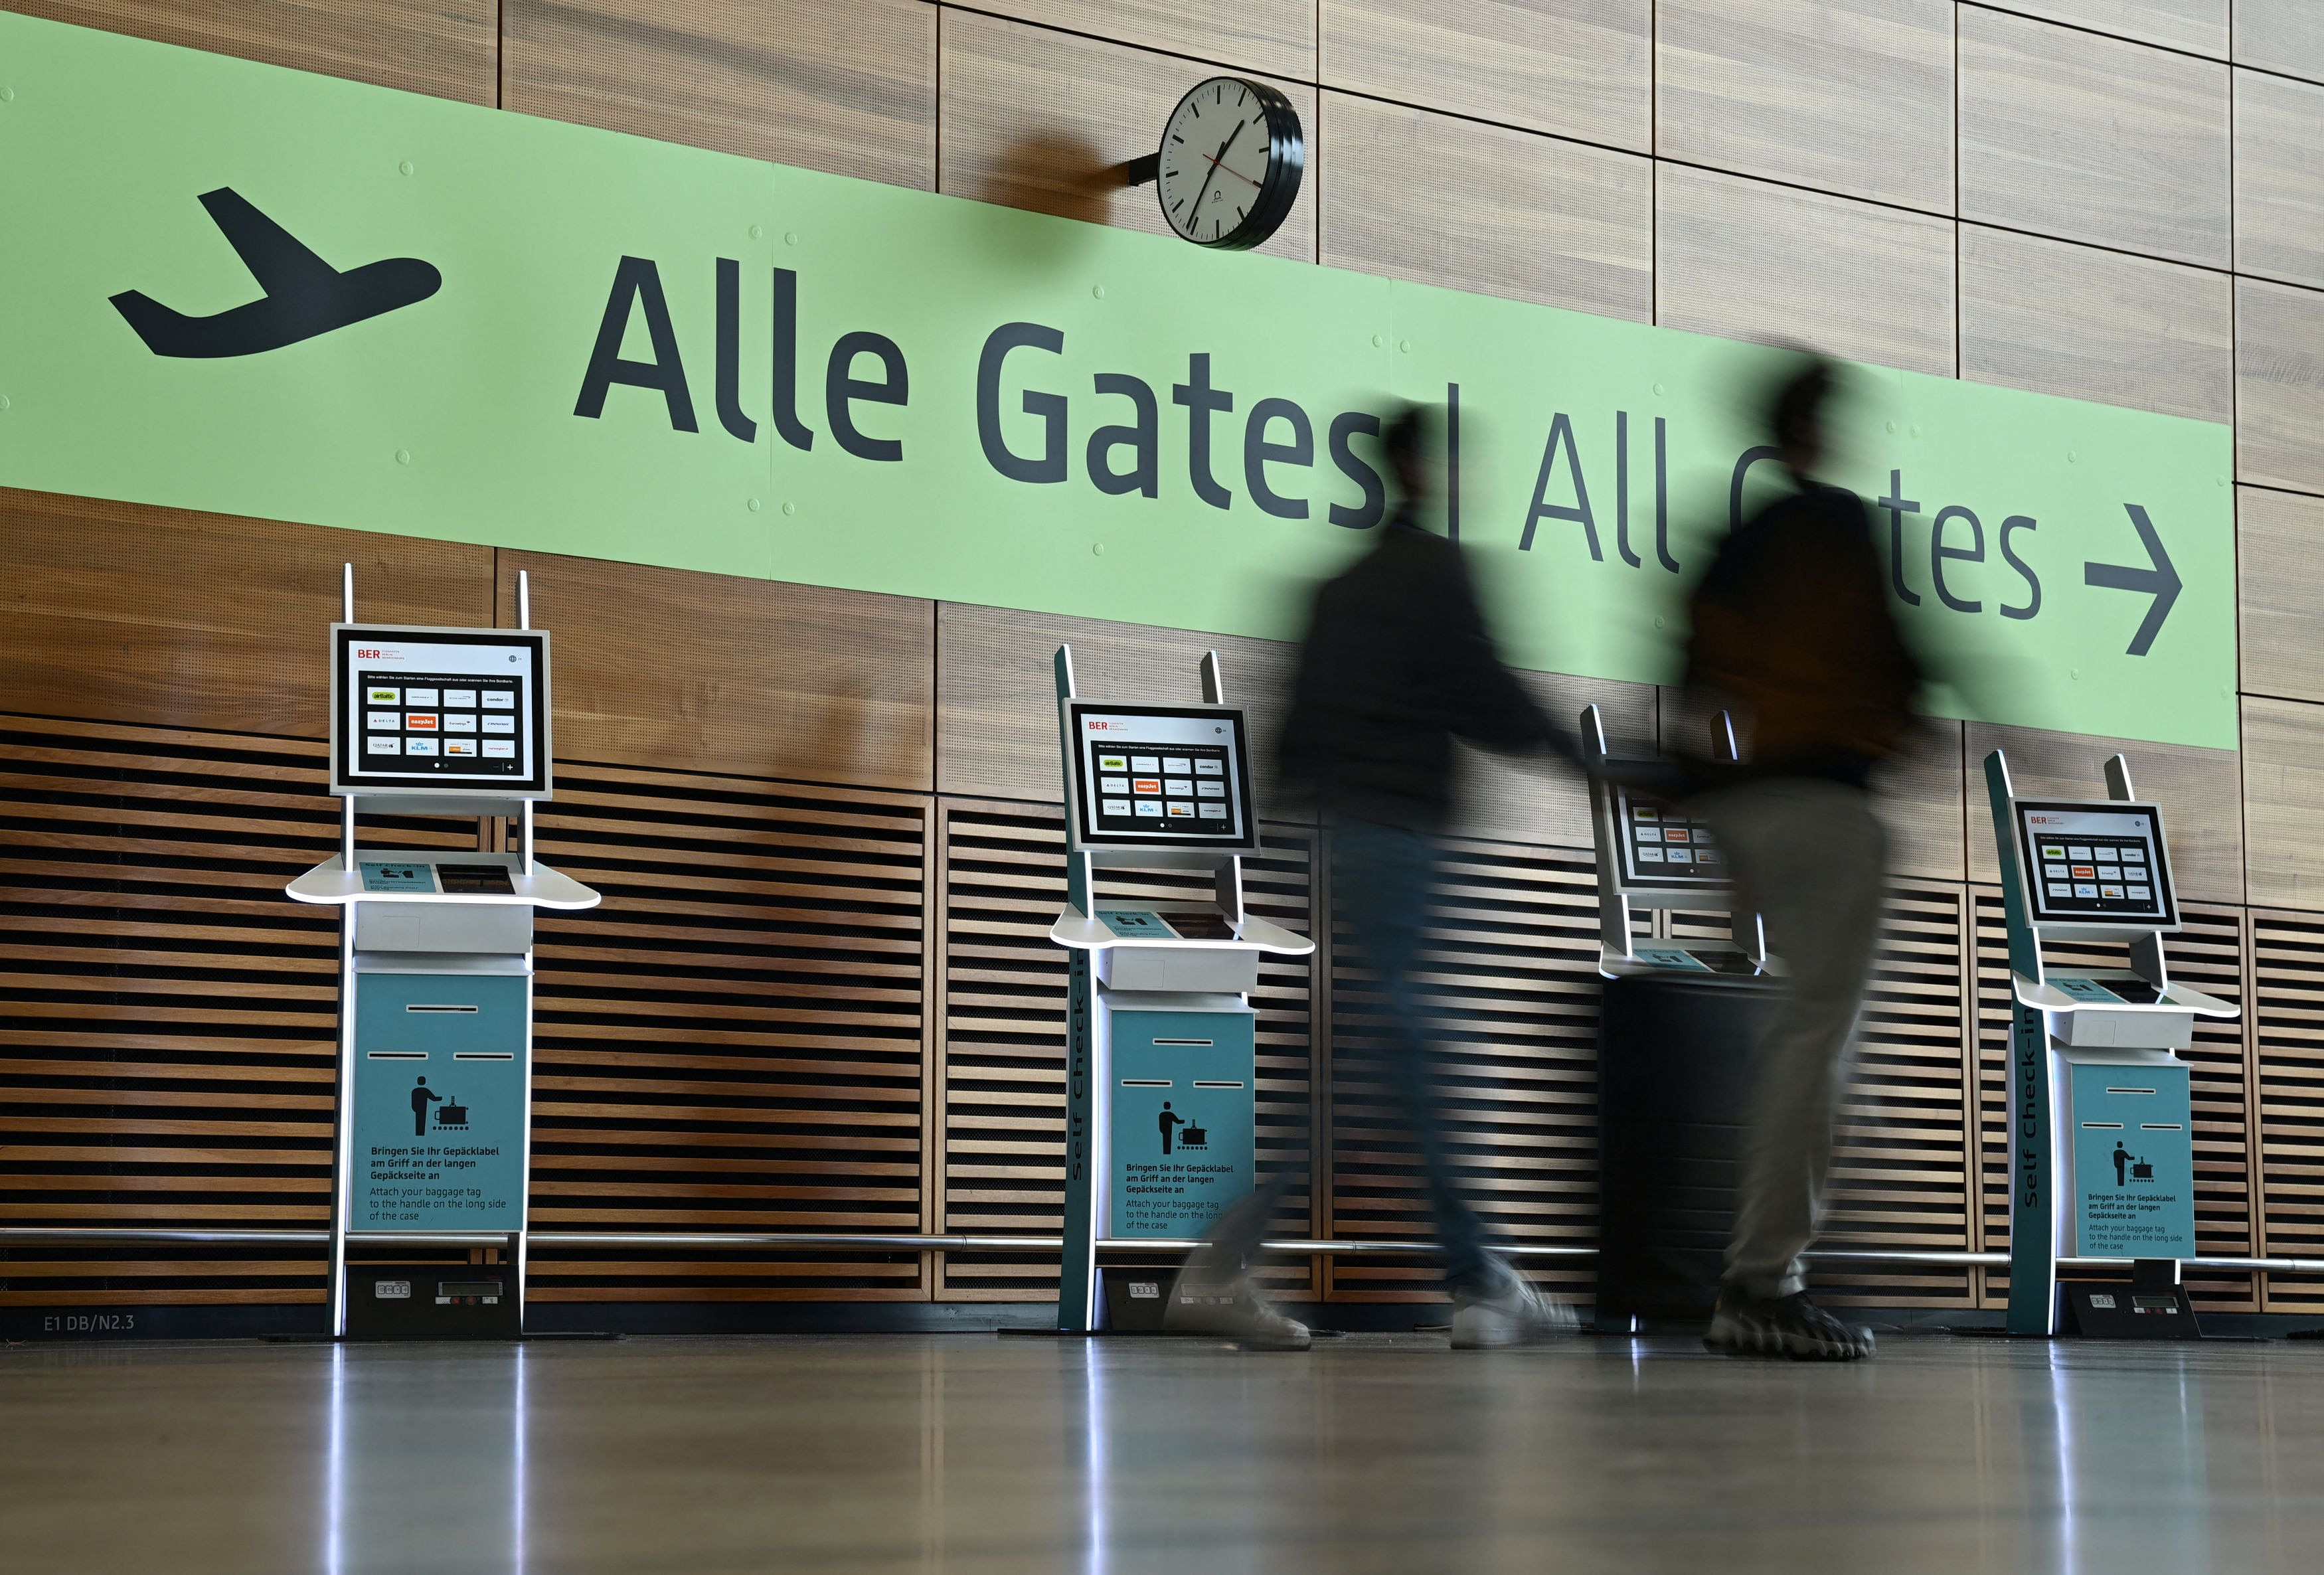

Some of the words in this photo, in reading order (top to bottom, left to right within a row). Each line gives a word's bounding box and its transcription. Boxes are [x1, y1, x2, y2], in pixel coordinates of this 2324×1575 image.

[573, 255, 908, 461] Alle
[976, 322, 1385, 529] Gates
[1518, 410, 1679, 574] All
[1730, 446, 2042, 620] tes
[358, 649, 380, 659] BER
[1089, 721, 1108, 730] BER
[1073, 948, 1084, 1099] Check-in
[2021, 1008, 2036, 1138] Check-in
[1072, 1112, 1082, 1181] Self
[371, 1147, 408, 1157] Bringen
[444, 1147, 499, 1157] Gepäcklabel
[388, 1159, 410, 1167] Griff
[444, 1159, 476, 1169] langen
[1126, 1164, 1157, 1173] Bringen
[1187, 1165, 1233, 1174] Gepäcklabel
[371, 1171, 426, 1181] Gepäckseite
[1188, 1175, 1214, 1185] langen
[2023, 1149, 2037, 1208] Self
[402, 1189, 422, 1198] your
[426, 1187, 463, 1198] baggage
[467, 1189, 481, 1198] tag
[1126, 1185, 1172, 1194] Gepäckseite
[466, 1200, 485, 1210] long
[1173, 1201, 1204, 1210] baggage
[1207, 1201, 1218, 1210] tag
[370, 1212, 379, 1220] of
[382, 1212, 396, 1220] the
[2127, 1224, 2153, 1233] baggage
[44, 1316, 60, 1331] E1
[67, 1314, 134, 1332] DB/N2.3
